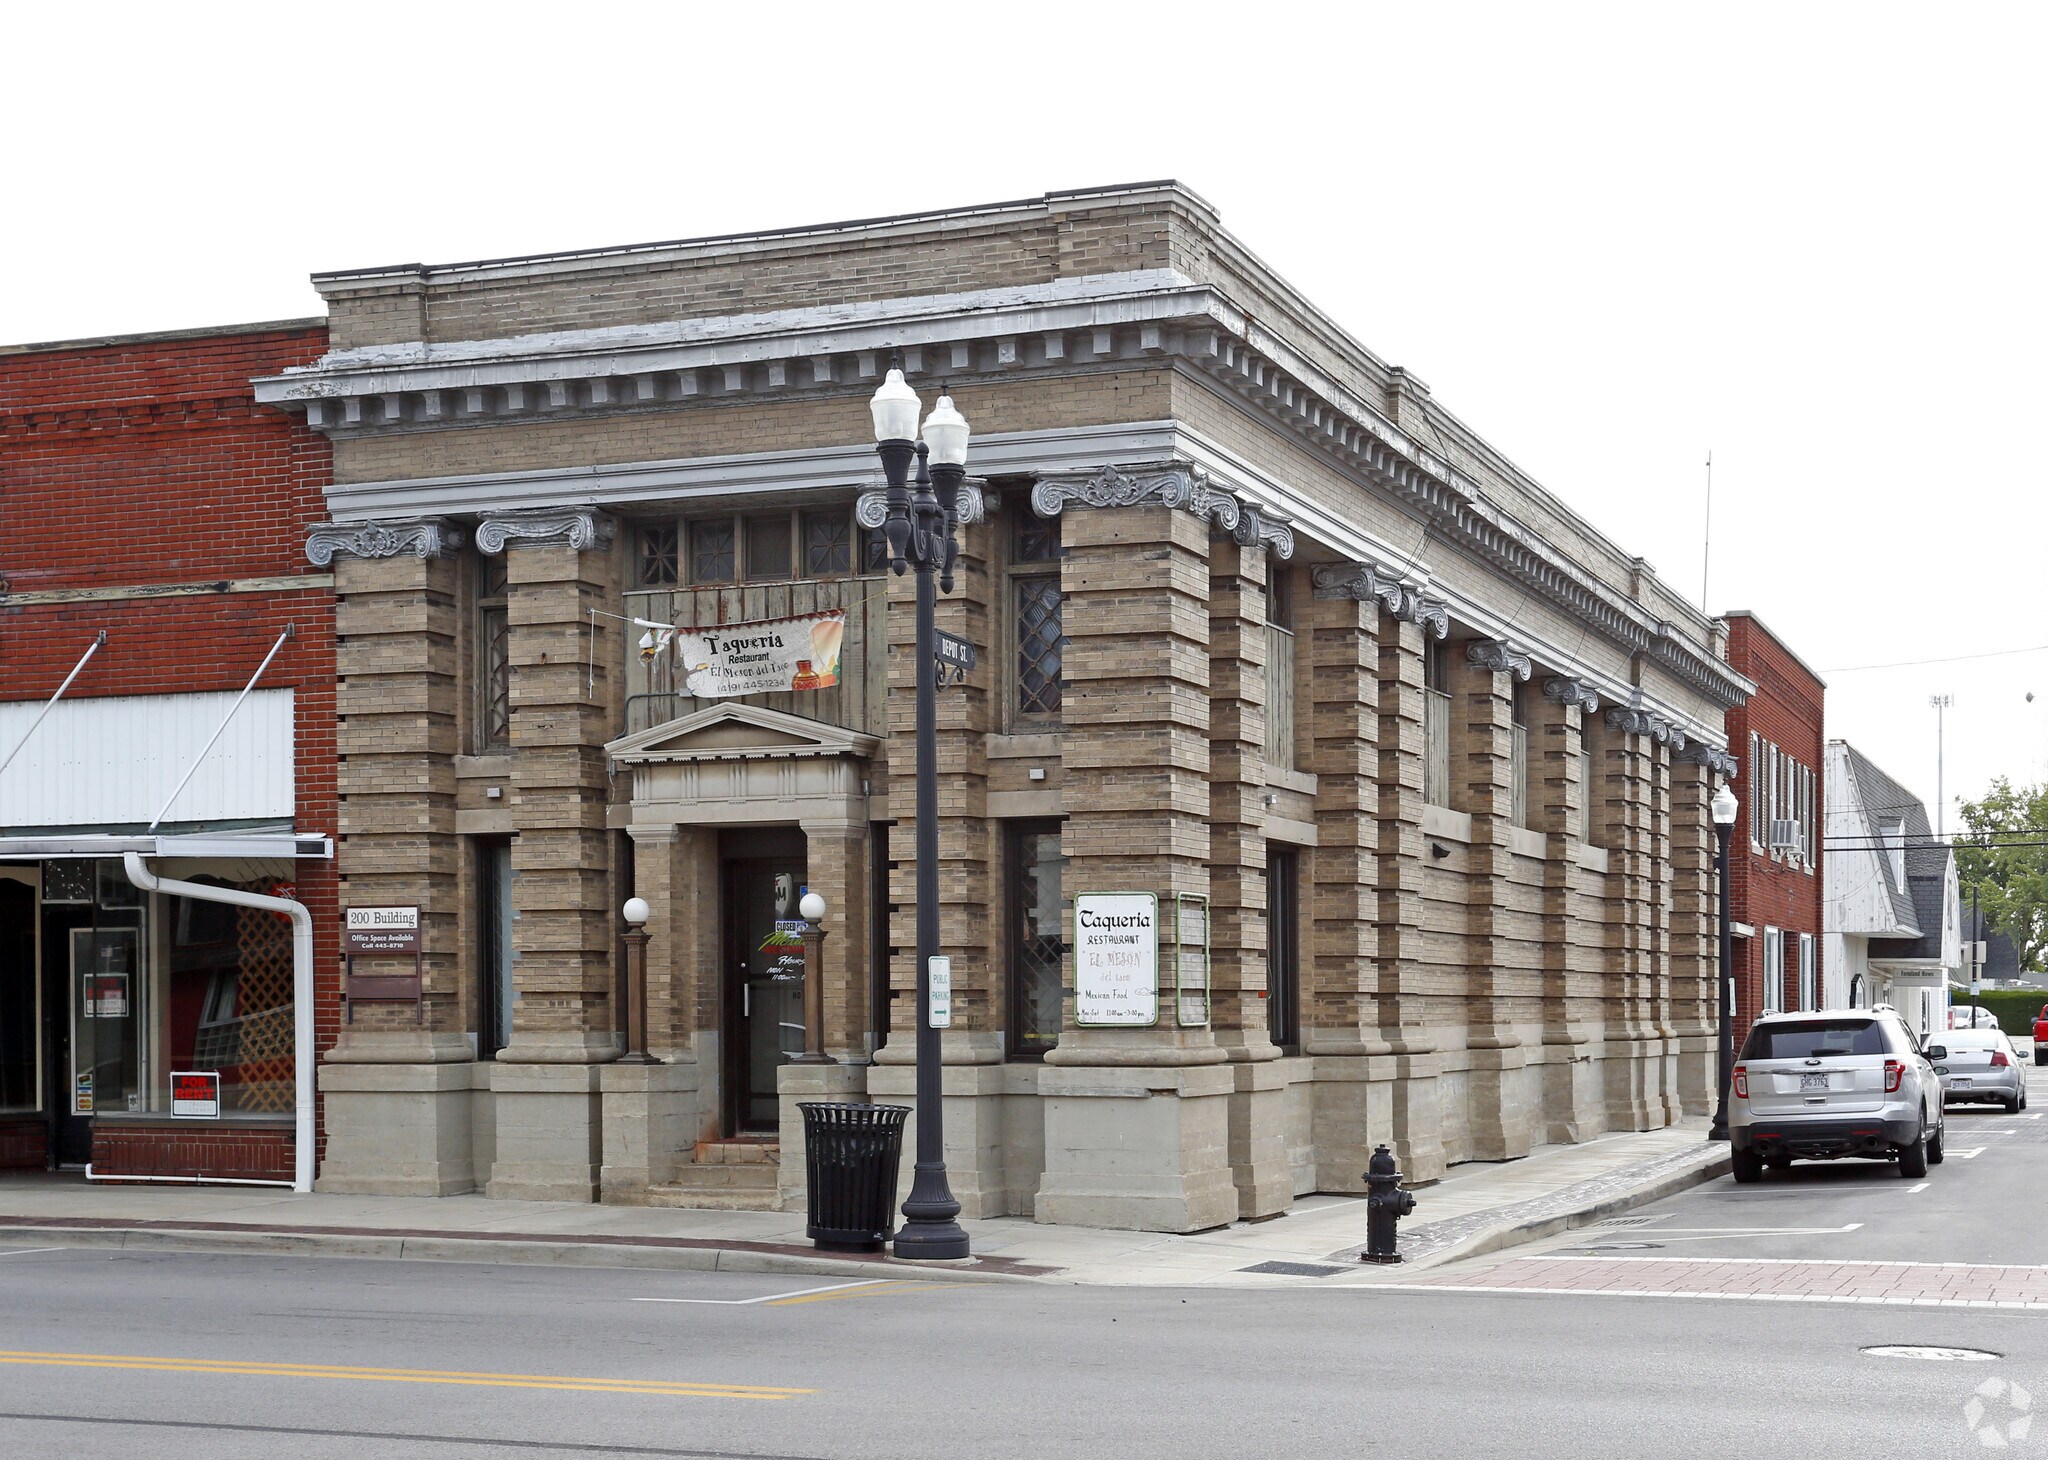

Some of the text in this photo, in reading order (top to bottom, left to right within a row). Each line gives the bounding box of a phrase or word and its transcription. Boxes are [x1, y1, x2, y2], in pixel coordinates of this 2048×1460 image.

[703, 631, 784, 655] Taqueria
[942, 637, 968, 663] DEPOT ST.
[728, 652, 770, 665] Restaurant
[756, 664, 768, 676] del
[743, 679, 785, 690] 445-1234
[351, 911, 416, 928] 200 Building
[1079, 909, 1151, 932] Taqueria
[776, 921, 797, 932] CLOSED
[351, 934, 414, 943] Office Space Available
[1087, 934, 1140, 946] RESTAURANT
[933, 974, 948, 984] PUBLIC
[932, 991, 950, 1001] PARKING
[1085, 988, 1128, 999] Mexican Food
[181, 1076, 208, 1088] FOR
[174, 1088, 214, 1100] RENT
